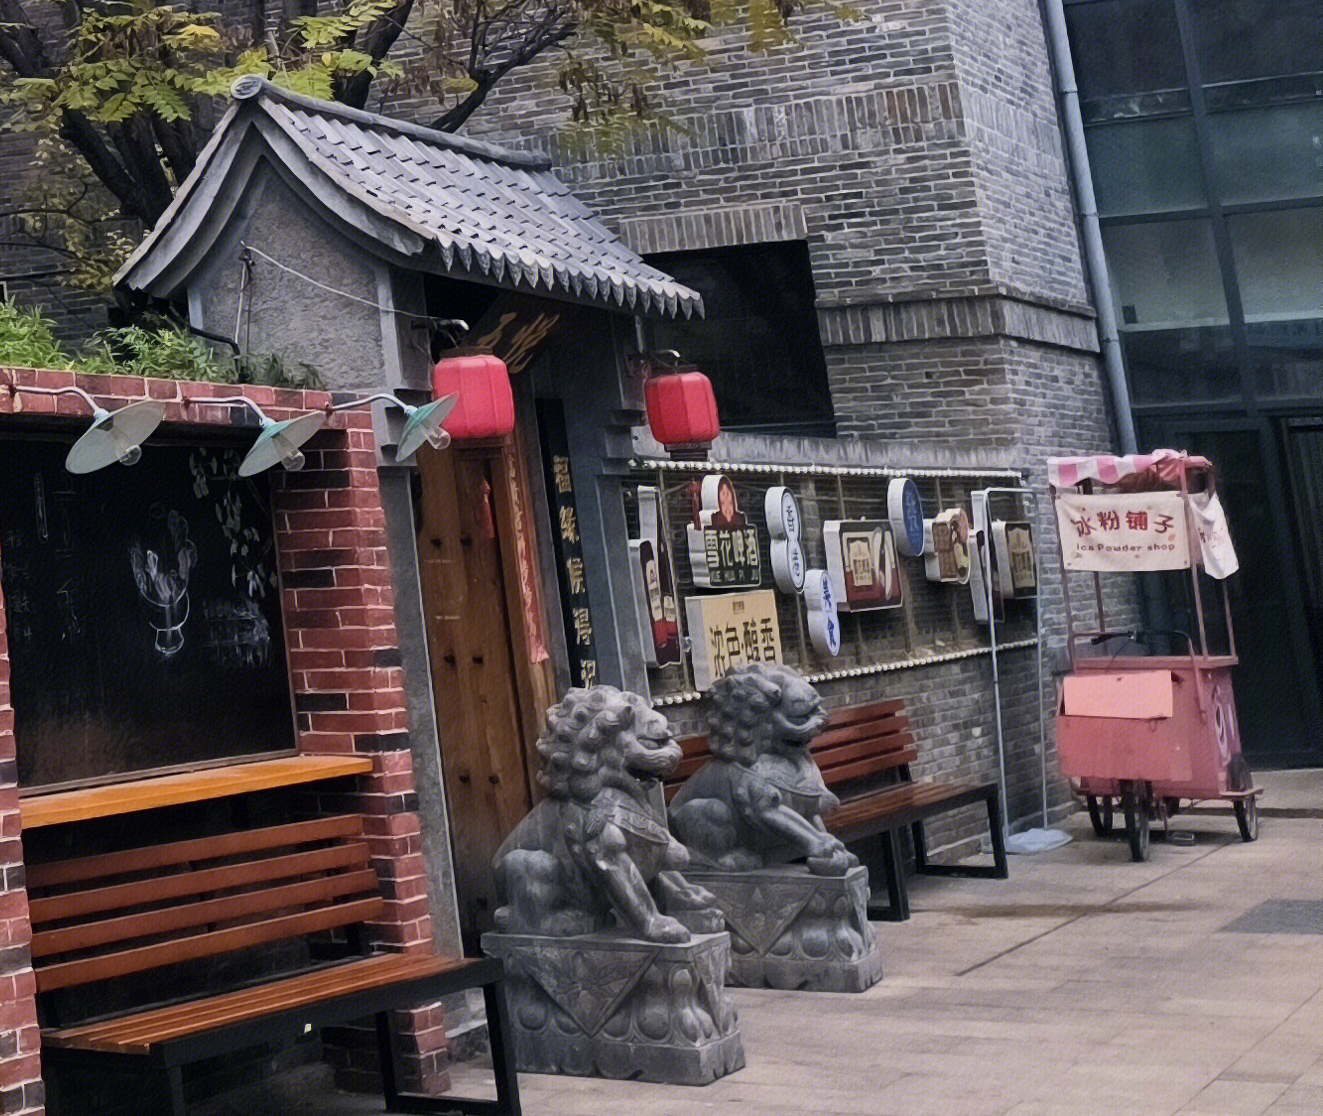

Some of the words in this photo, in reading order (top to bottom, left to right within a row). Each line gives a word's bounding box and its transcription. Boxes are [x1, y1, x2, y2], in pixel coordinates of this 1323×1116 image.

[1070, 510, 1174, 537] 冰粉铺子
[704, 529, 758, 568] 雪花啤酒
[1097, 543, 1143, 552] Powder
[1147, 543, 1175, 553] shop
